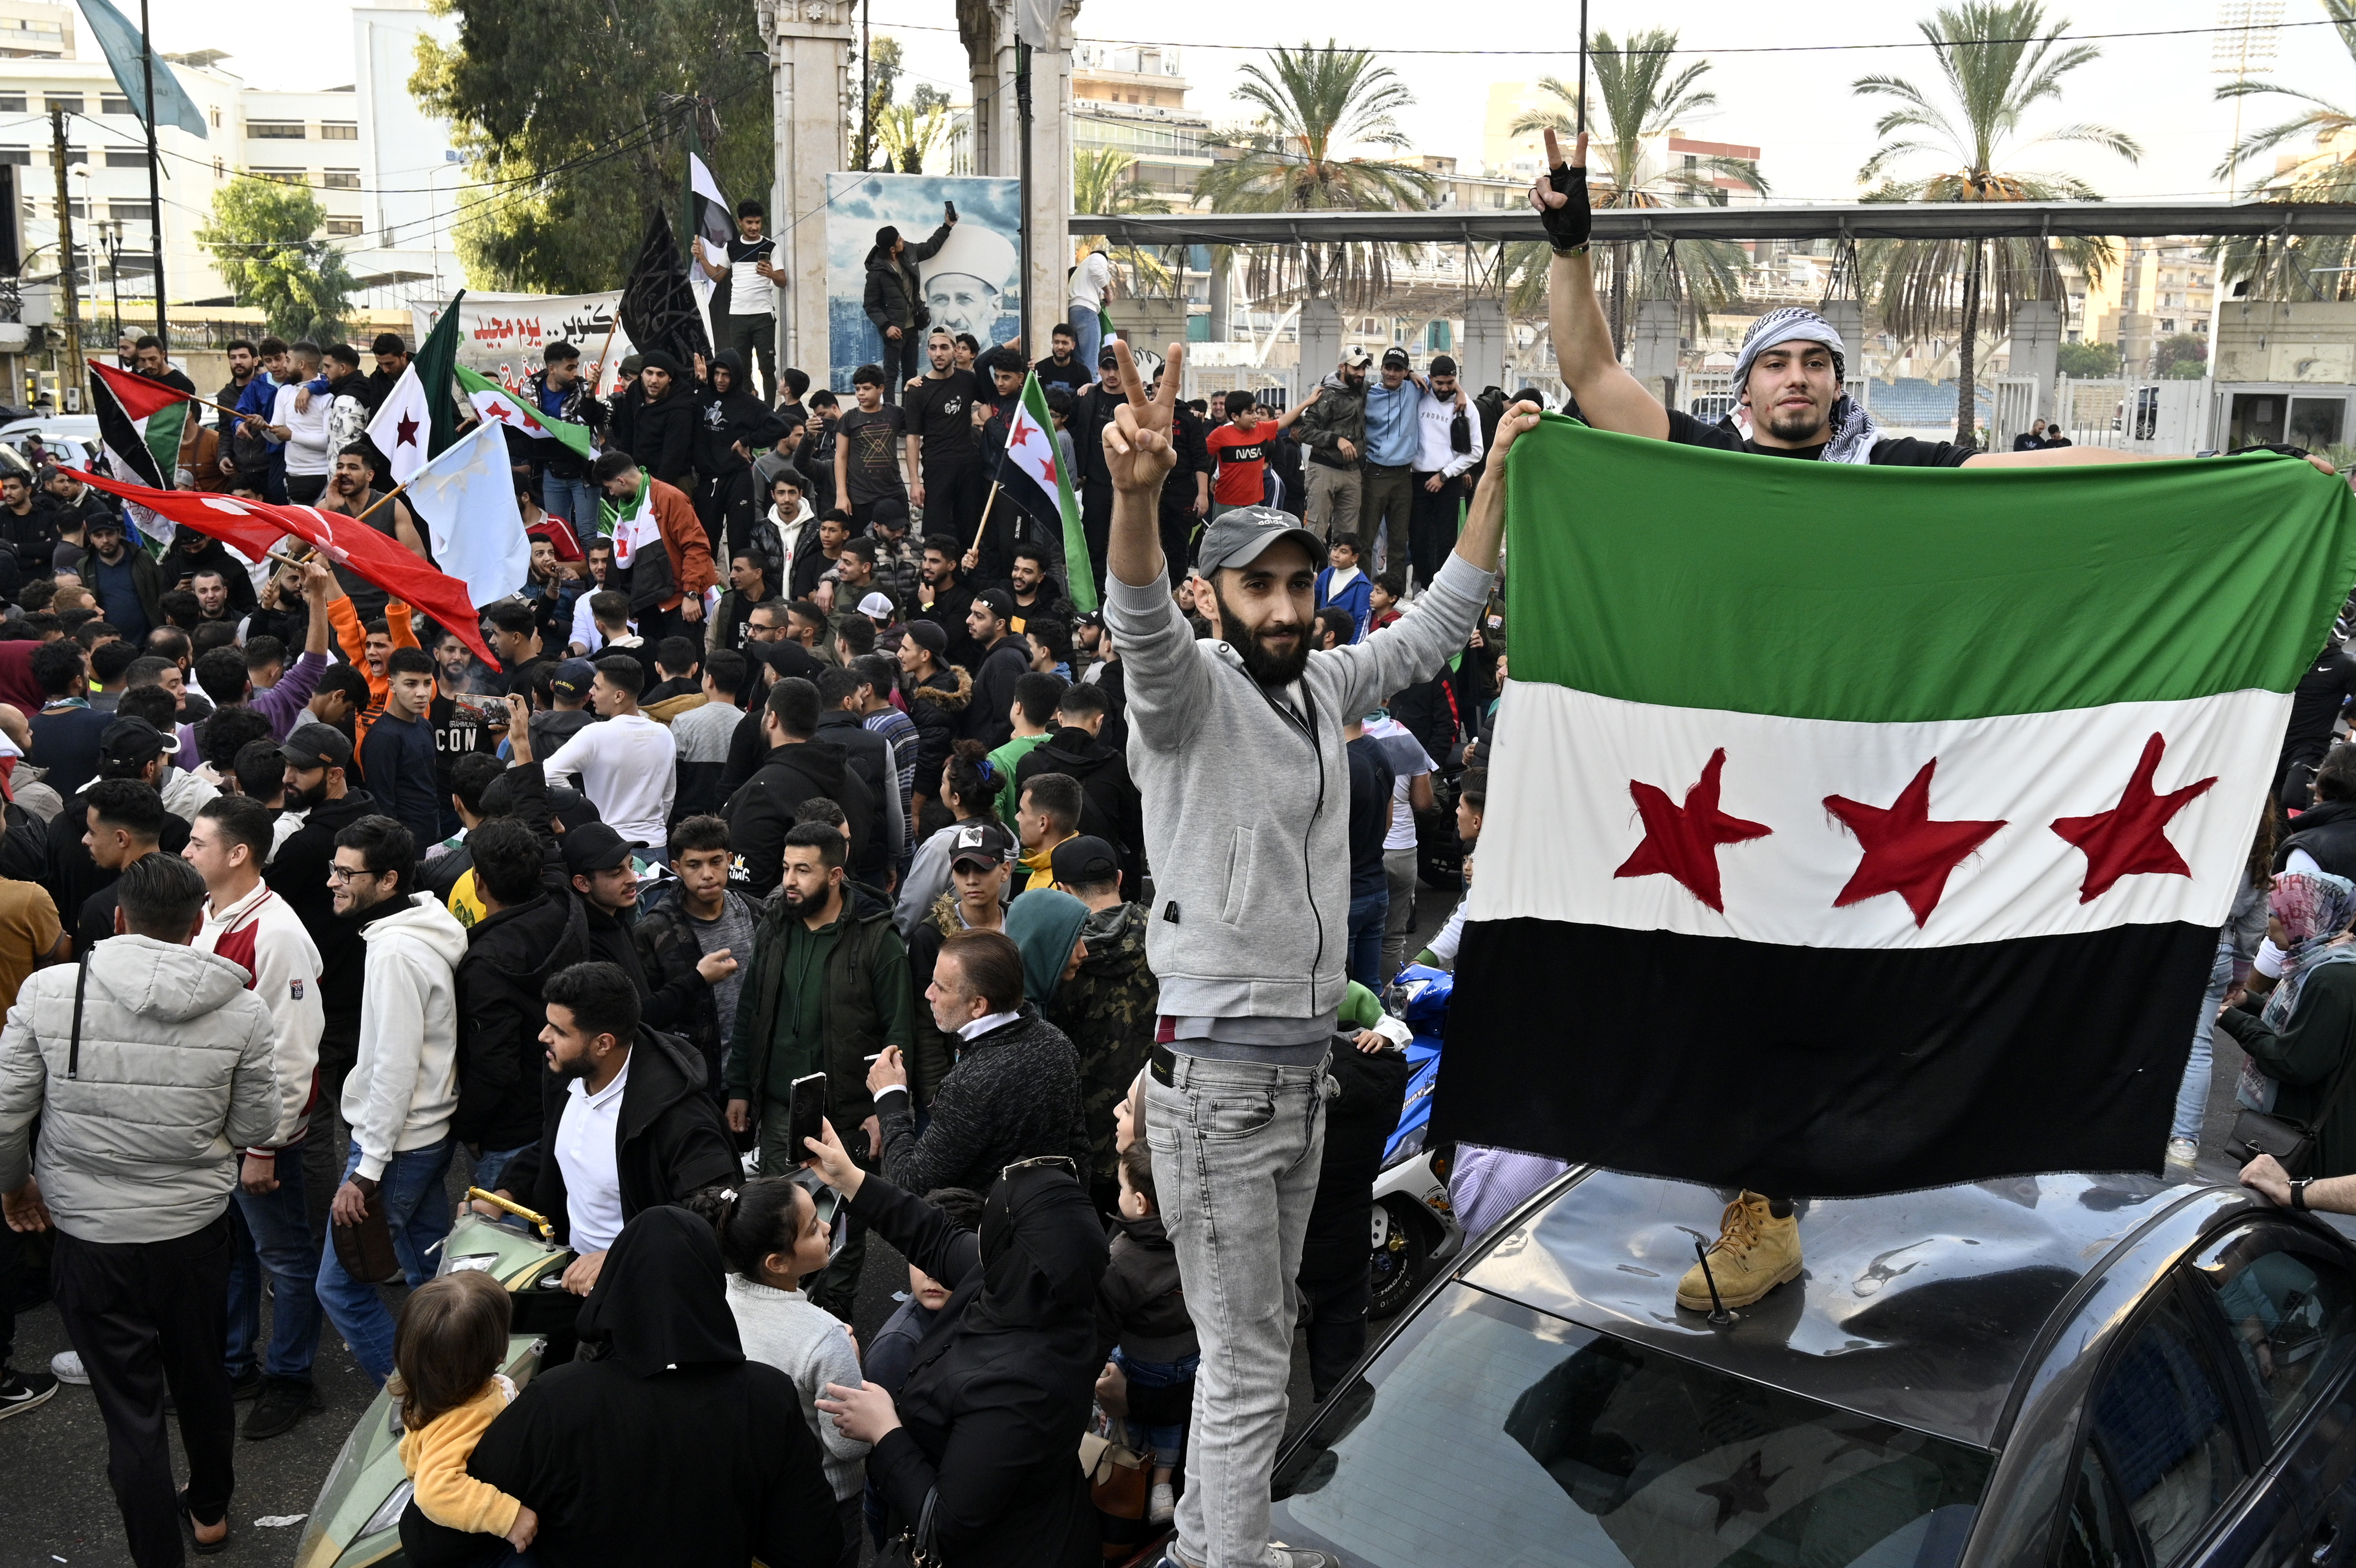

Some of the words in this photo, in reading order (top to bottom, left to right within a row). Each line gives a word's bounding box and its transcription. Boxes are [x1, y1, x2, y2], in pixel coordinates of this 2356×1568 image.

[474, 314, 514, 350] مجيد
[517, 315, 542, 349] يوم
[1388, 349, 1405, 359] BOSS
[1236, 447, 1262, 459] NASA
[1258, 519, 1289, 527] adidas
[555, 680, 576, 691] CALIENTE
